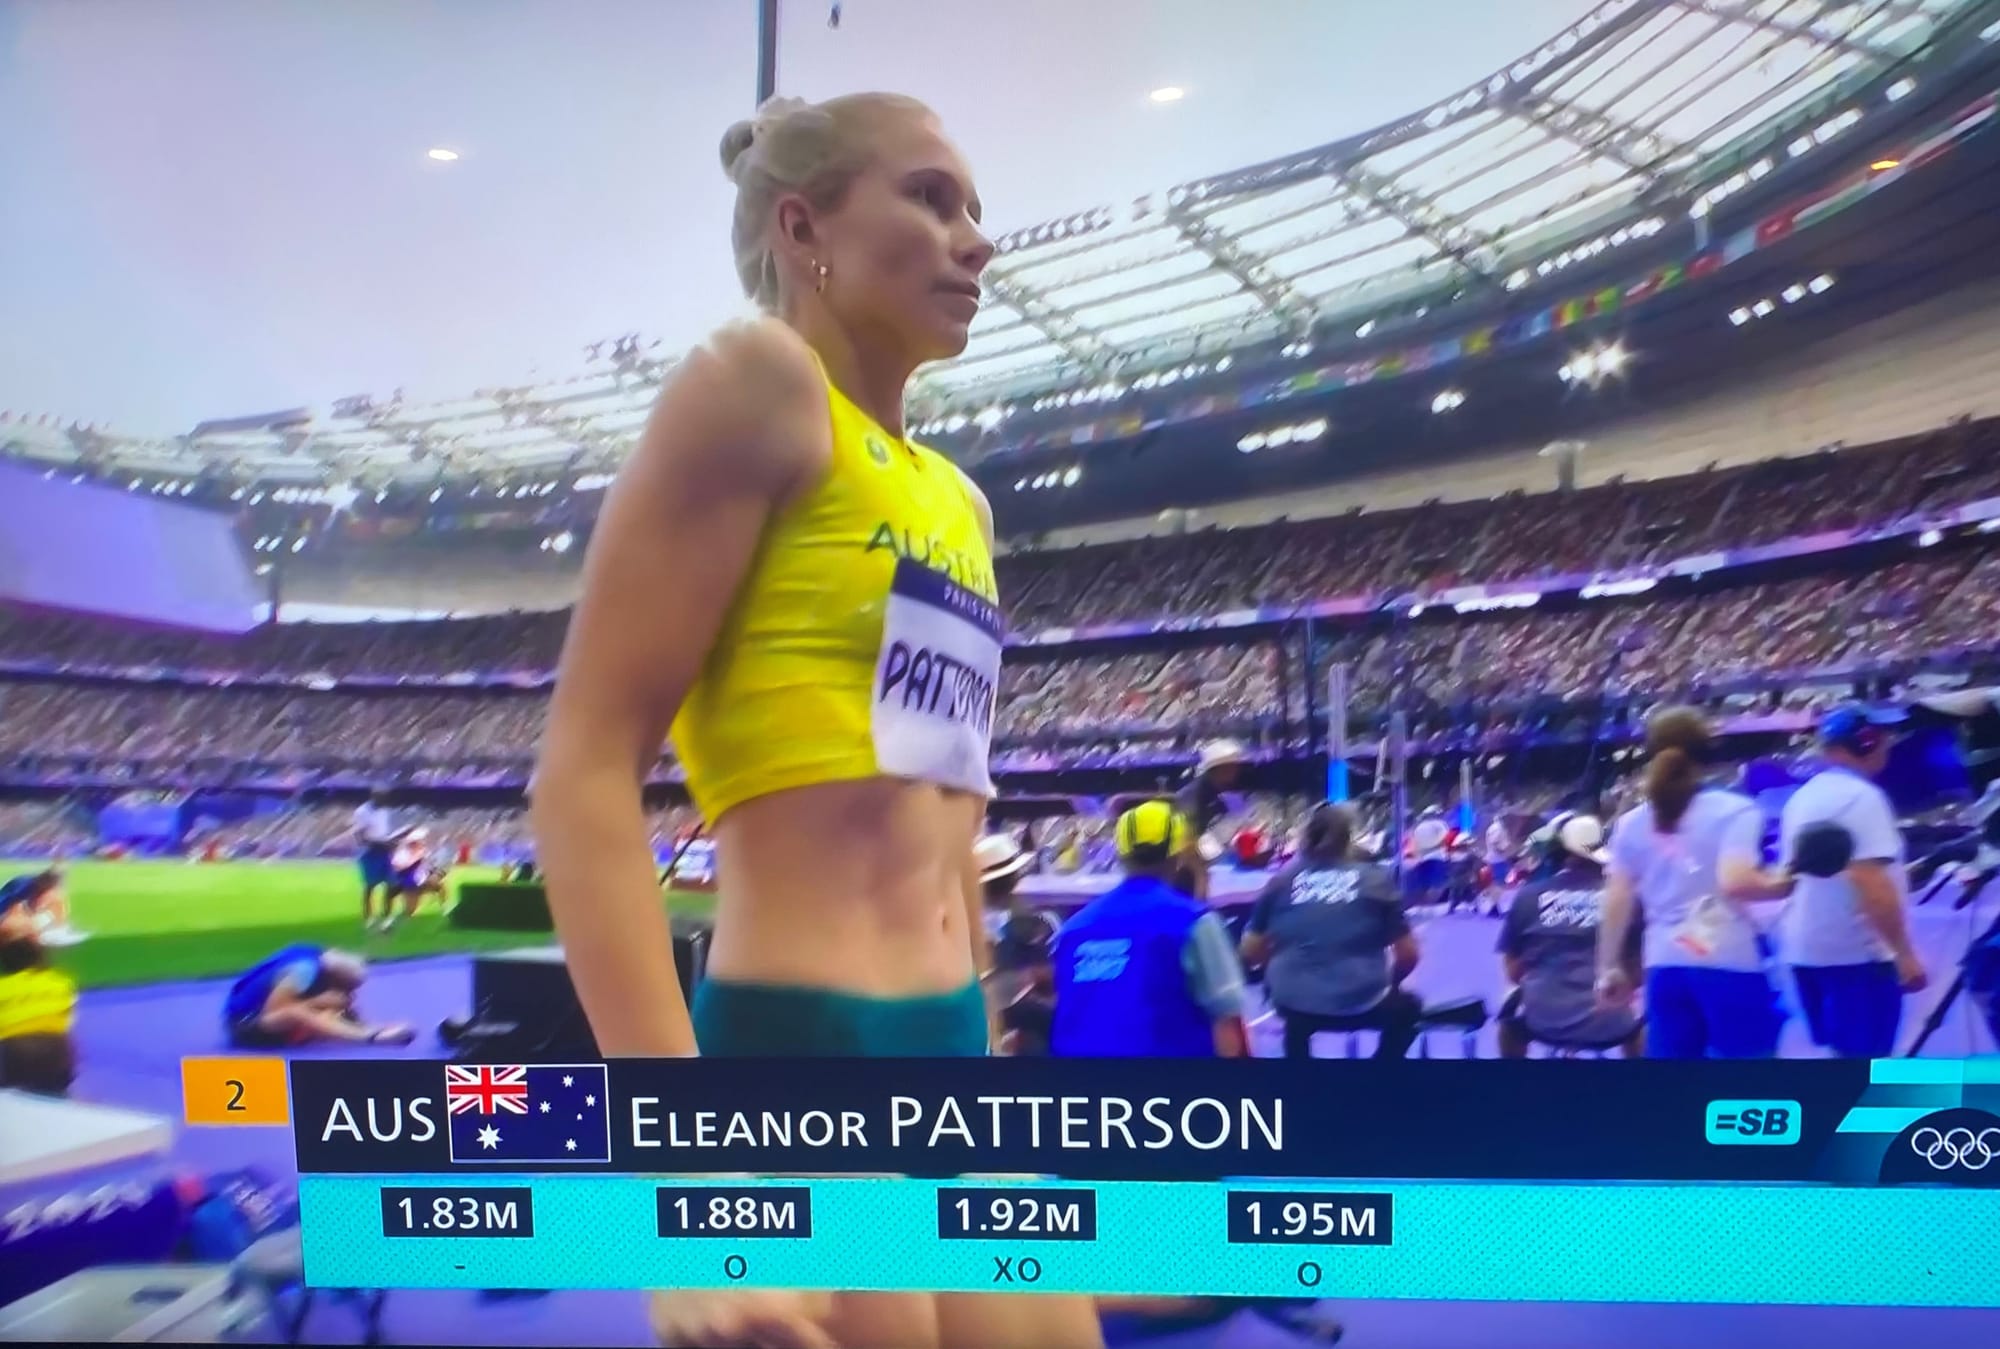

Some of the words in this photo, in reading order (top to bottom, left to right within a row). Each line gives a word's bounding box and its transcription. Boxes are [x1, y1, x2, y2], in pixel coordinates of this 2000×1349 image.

[225, 1080, 246, 1111] 2
[321, 1097, 436, 1142] AUS
[891, 1096, 1283, 1151] PATTERSON
[1715, 1108, 1790, 1136] =SB
[398, 1197, 518, 1230] 1.83M
[674, 1196, 796, 1230] 1.88M
[955, 1198, 1080, 1232] 1.92M
[1246, 1201, 1376, 1237] 1.95M
[993, 1256, 1042, 1283] XO
